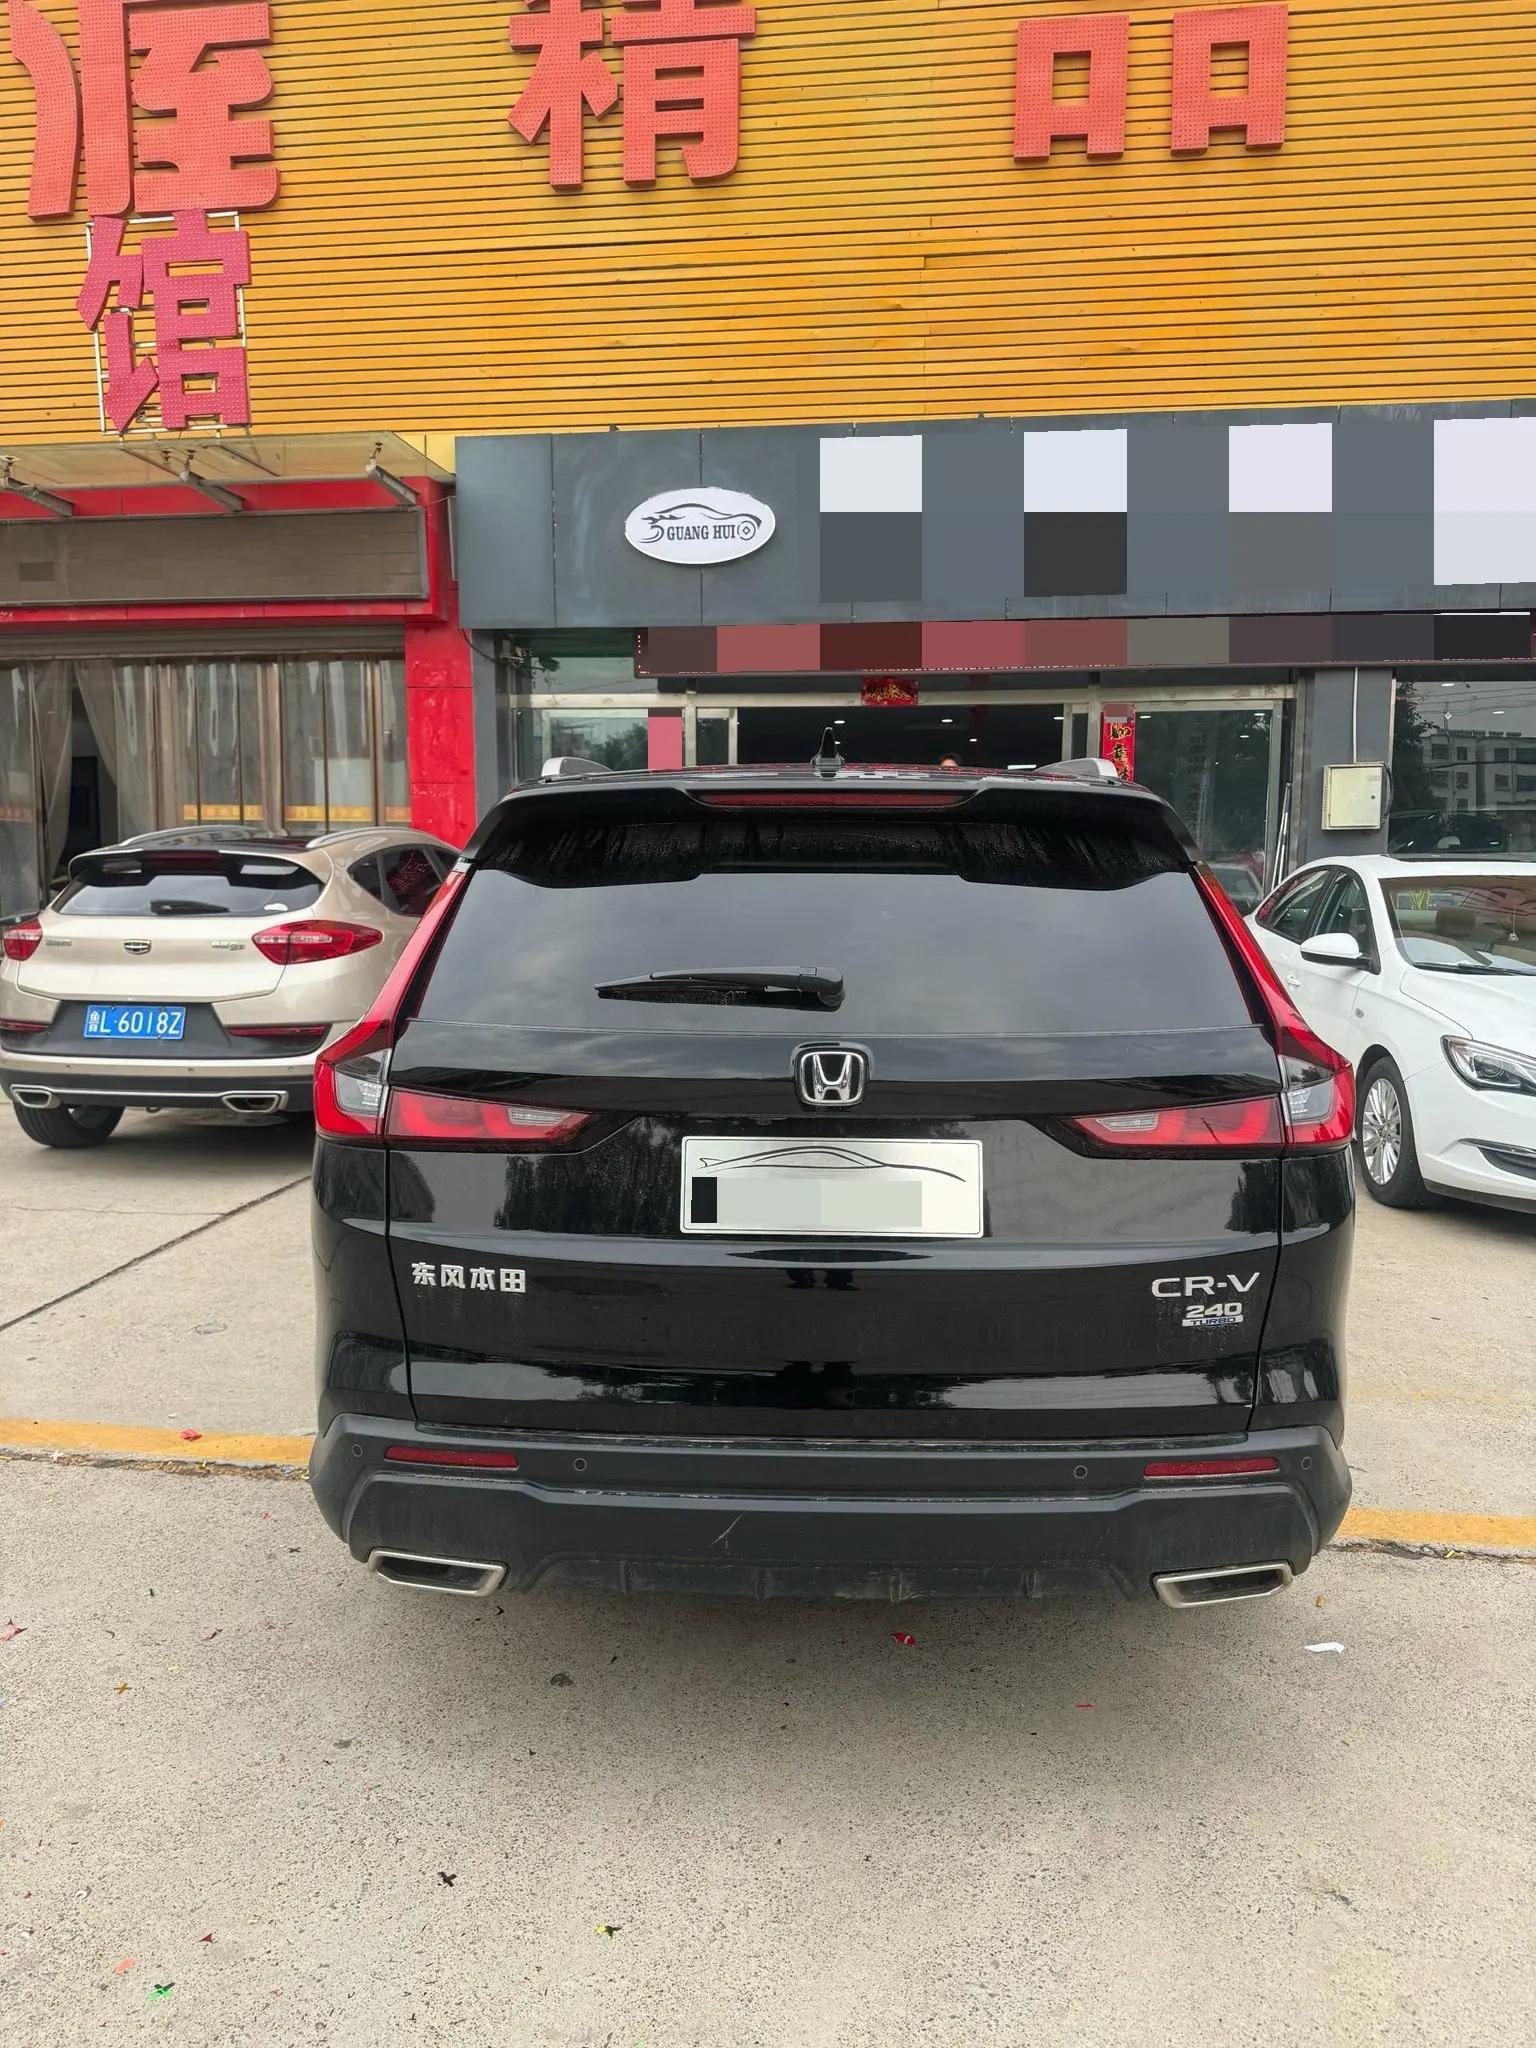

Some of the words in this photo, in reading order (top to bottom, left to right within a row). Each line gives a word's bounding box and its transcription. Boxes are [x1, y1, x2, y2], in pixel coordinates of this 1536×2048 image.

[76, 209, 252, 433] 馆
[667, 525, 709, 540] GUANG
[713, 525, 736, 539] HUI
[411, 1262, 526, 1293] 东风本田
[1151, 1272, 1260, 1298] CR-V
[1186, 1302, 1242, 1319] 240
